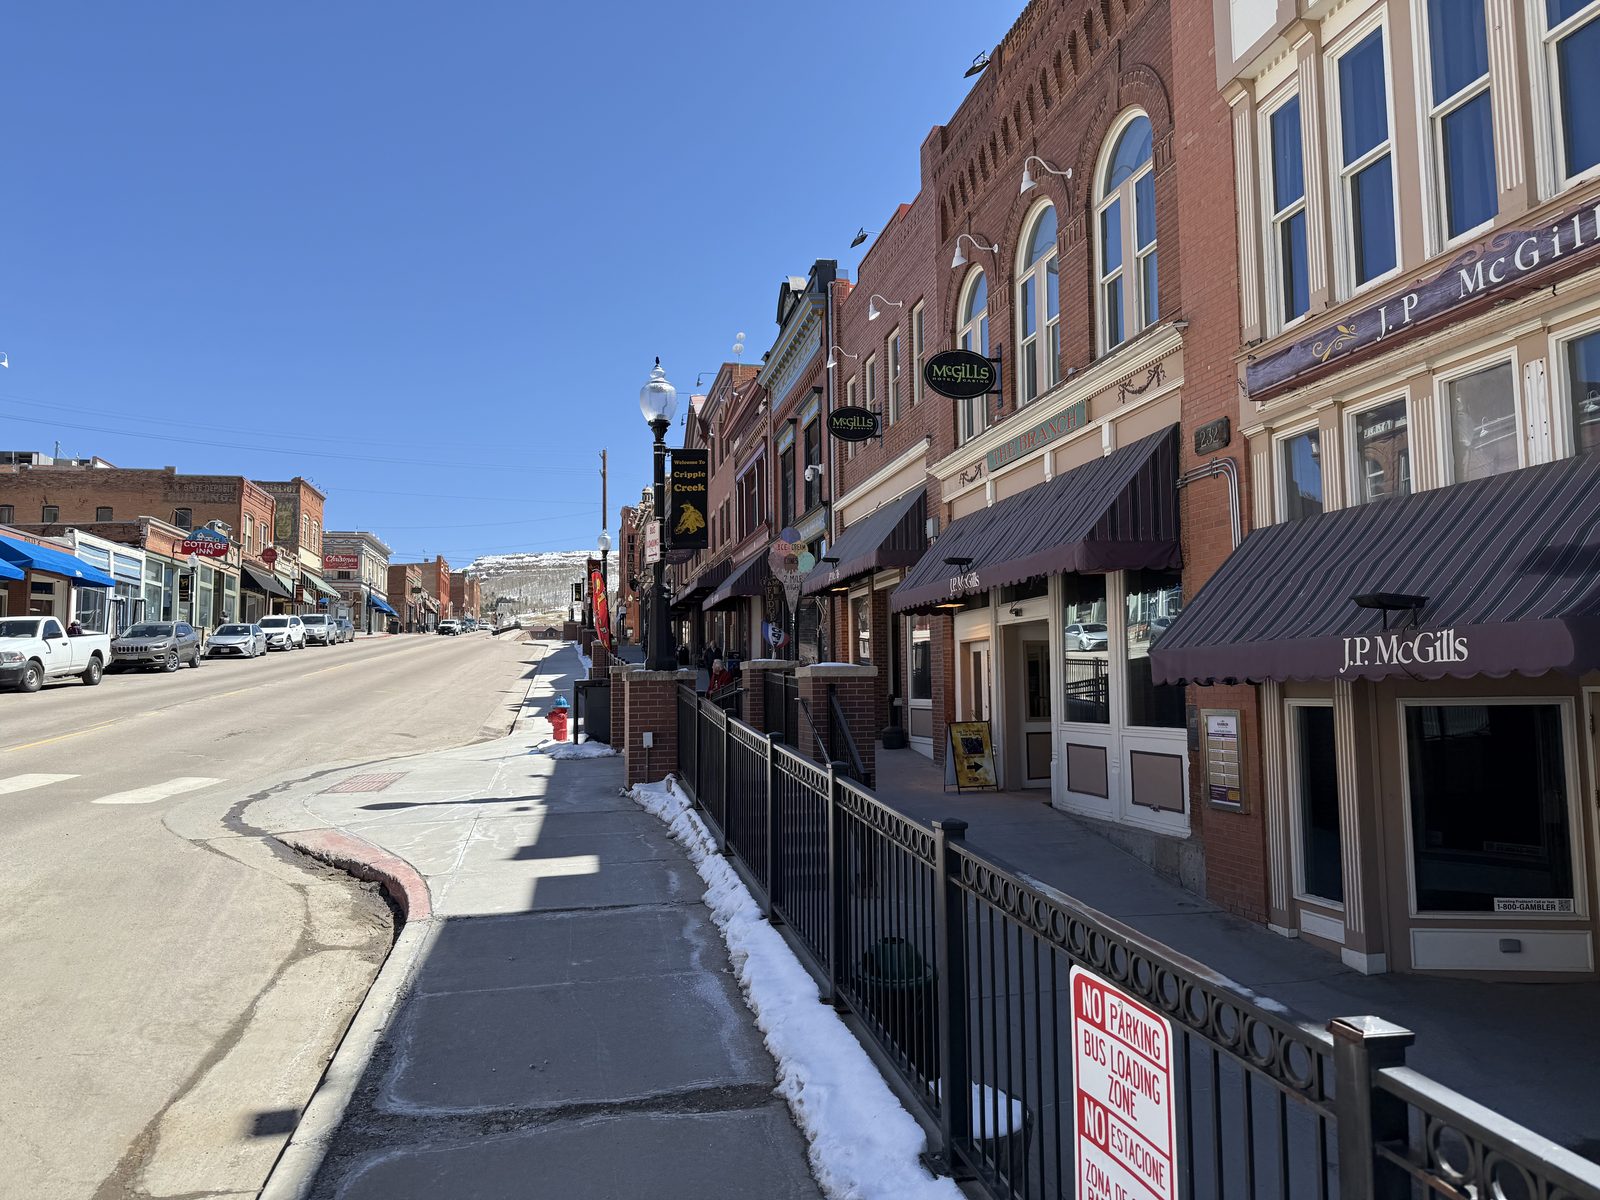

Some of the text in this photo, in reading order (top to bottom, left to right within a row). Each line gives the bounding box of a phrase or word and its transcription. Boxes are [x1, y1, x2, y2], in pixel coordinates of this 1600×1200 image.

[993, 407, 1077, 464] THE BRANCH
[673, 471, 706, 479] Cripple
[673, 483, 706, 492] Creek
[183, 540, 228, 550] COTTAGE
[195, 547, 214, 555] INN
[777, 543, 788, 551] ICE
[1339, 629, 1469, 673] J.P. McGills
[1498, 903, 1556, 911] 1-800-GAMBLER
[1082, 981, 1160, 1061] NO PARKING
[1084, 1028, 1160, 1105] BUS LOADING
[1108, 1074, 1137, 1122] ZONE
[1083, 1096, 1166, 1191] NO ESTACIONE
[1085, 1158, 1112, 1200] ZONA
